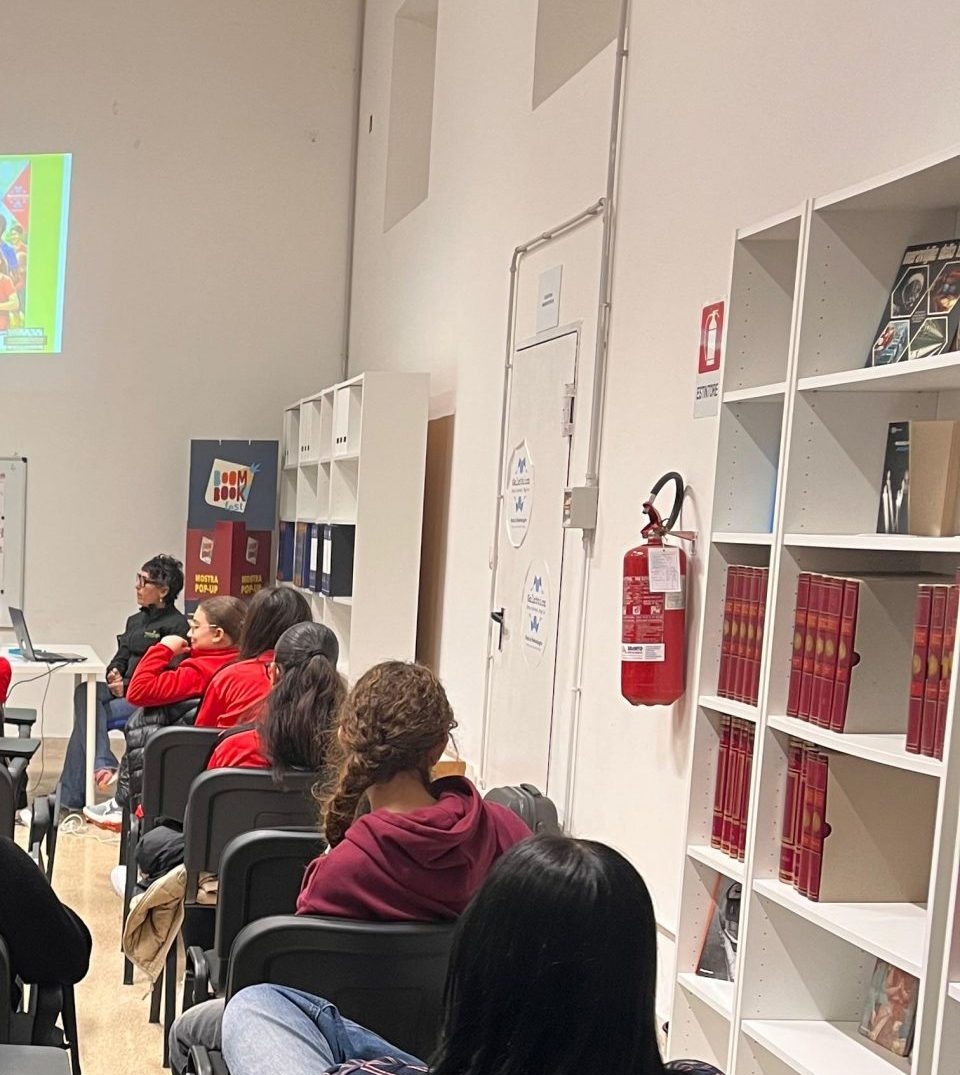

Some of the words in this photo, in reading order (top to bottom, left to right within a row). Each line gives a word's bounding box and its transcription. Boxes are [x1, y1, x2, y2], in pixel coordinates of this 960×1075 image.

[214, 470, 248, 486] BOOM
[213, 485, 246, 502] BOOK
[195, 573, 219, 584] MOSTRA
[194, 583, 218, 594] POP-UP
